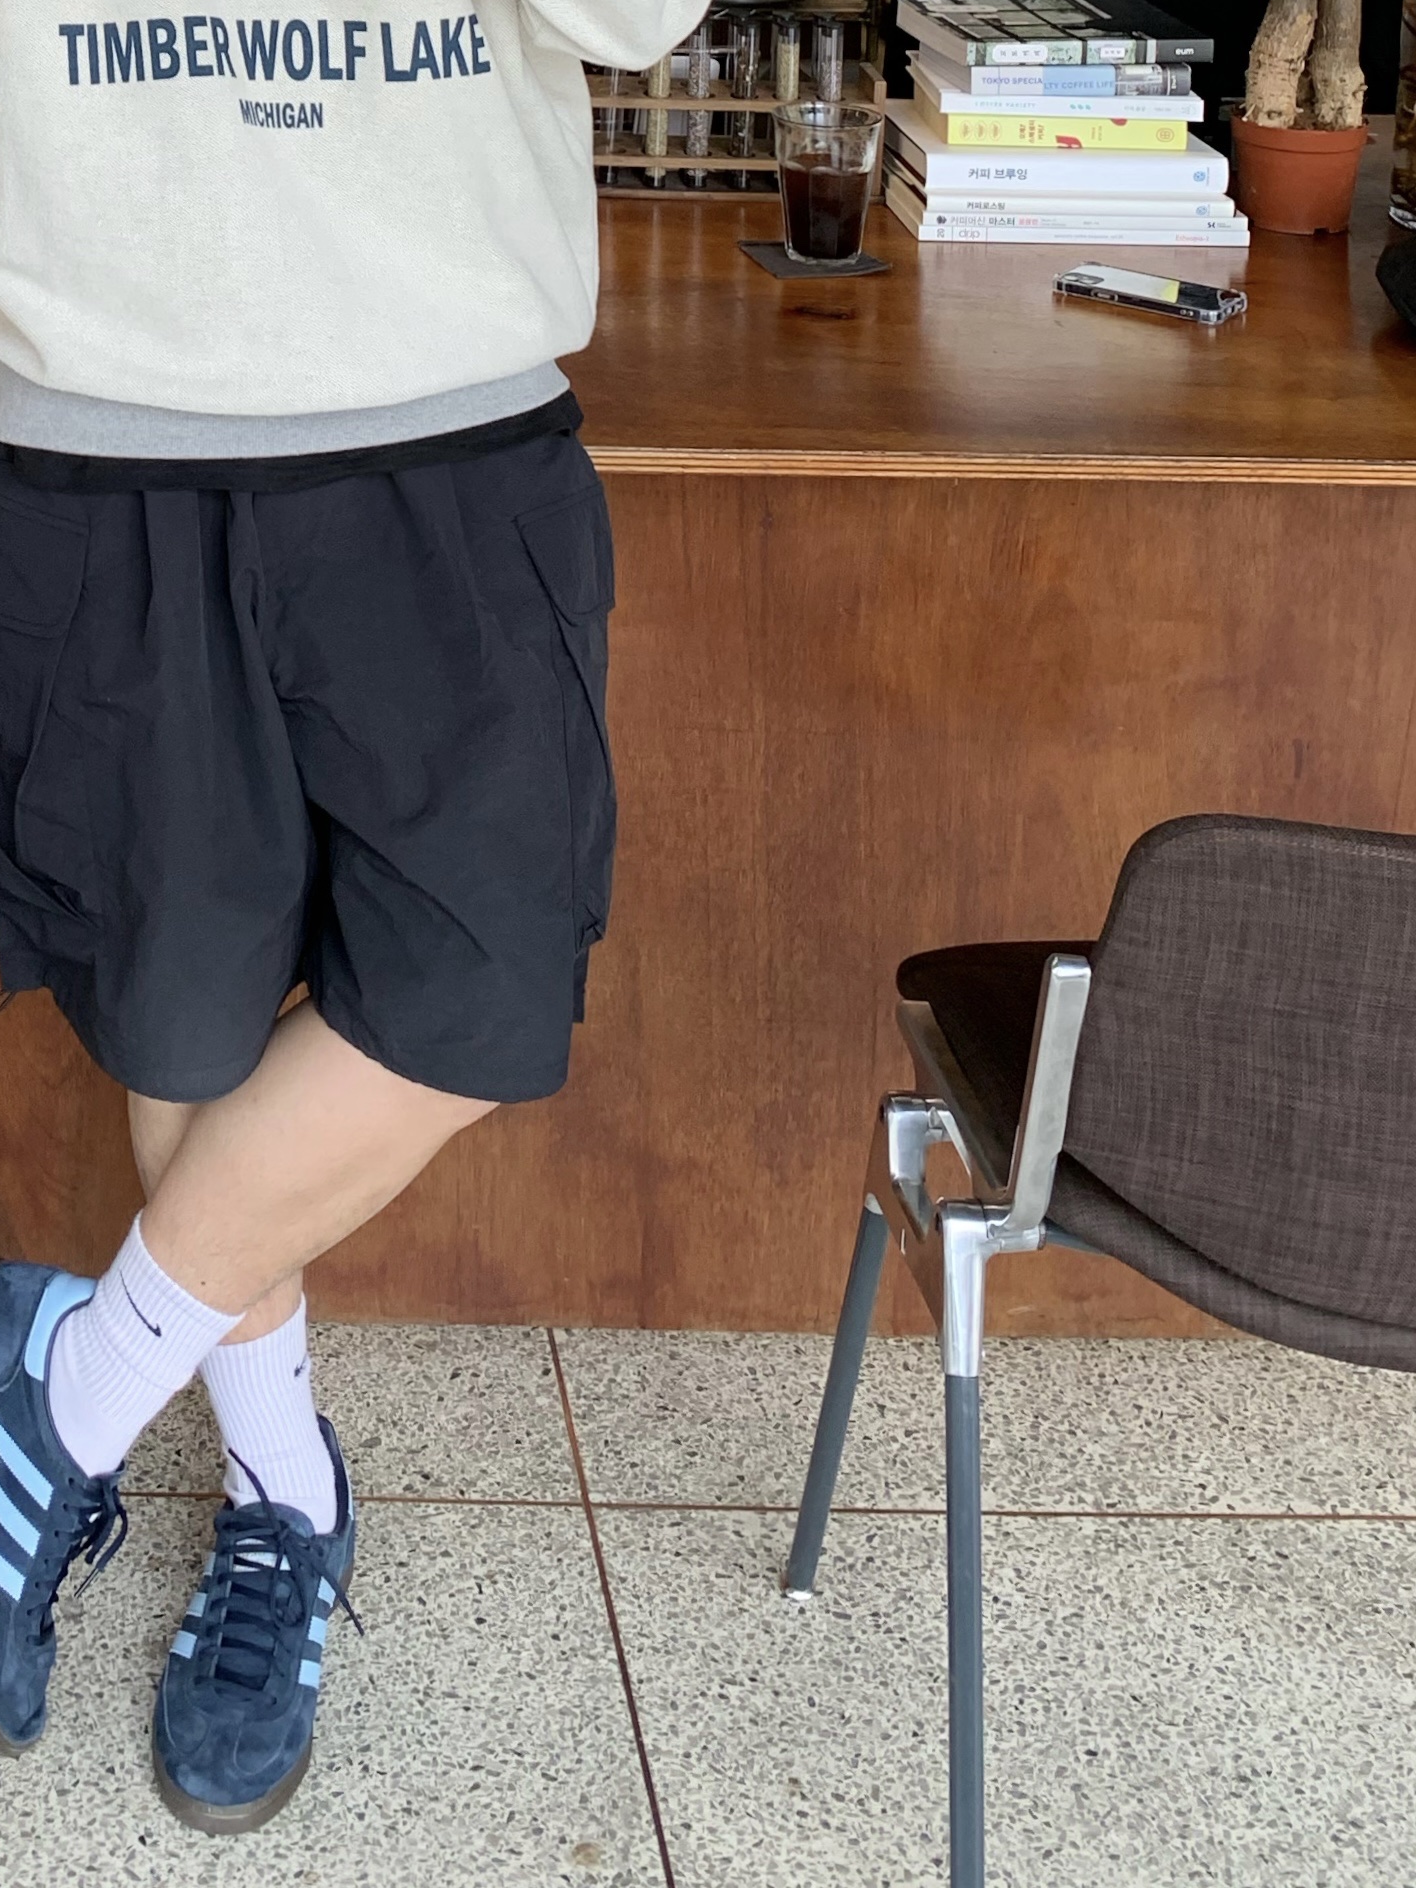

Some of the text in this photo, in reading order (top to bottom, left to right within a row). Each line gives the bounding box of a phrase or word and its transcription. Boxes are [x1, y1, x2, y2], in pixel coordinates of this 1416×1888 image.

[379, 13, 492, 83] LAKE
[1175, 47, 1194, 56] eum
[981, 76, 1011, 85] TOKYO
[1062, 81, 1094, 90] COFFEE
[1096, 80, 1115, 89] LIFE
[238, 99, 324, 129] MICHIGAN
[968, 167, 1029, 181] 커피 브루잉
[988, 217, 1016, 227] 마스터
